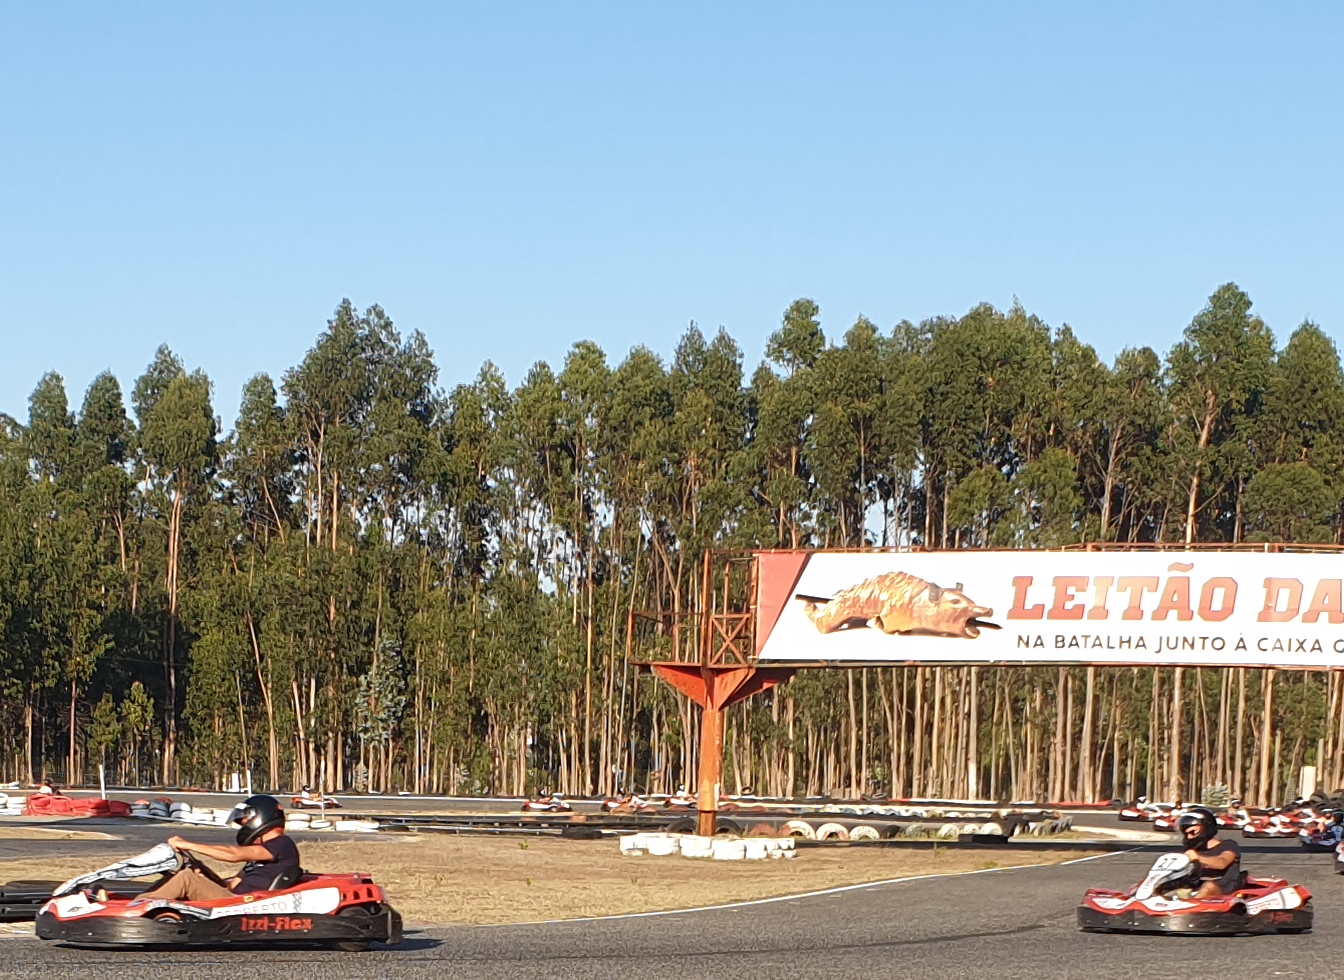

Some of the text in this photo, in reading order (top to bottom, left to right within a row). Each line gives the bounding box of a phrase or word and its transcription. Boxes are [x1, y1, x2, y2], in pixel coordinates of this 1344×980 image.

[1006, 562, 1239, 622] LEITÃO
[1017, 634, 1045, 649] NA
[1054, 634, 1147, 650] BATALHA
[1154, 635, 1226, 654] JUNTO
[1257, 637, 1323, 653] CAIXA
[1157, 857, 1178, 870] 27
